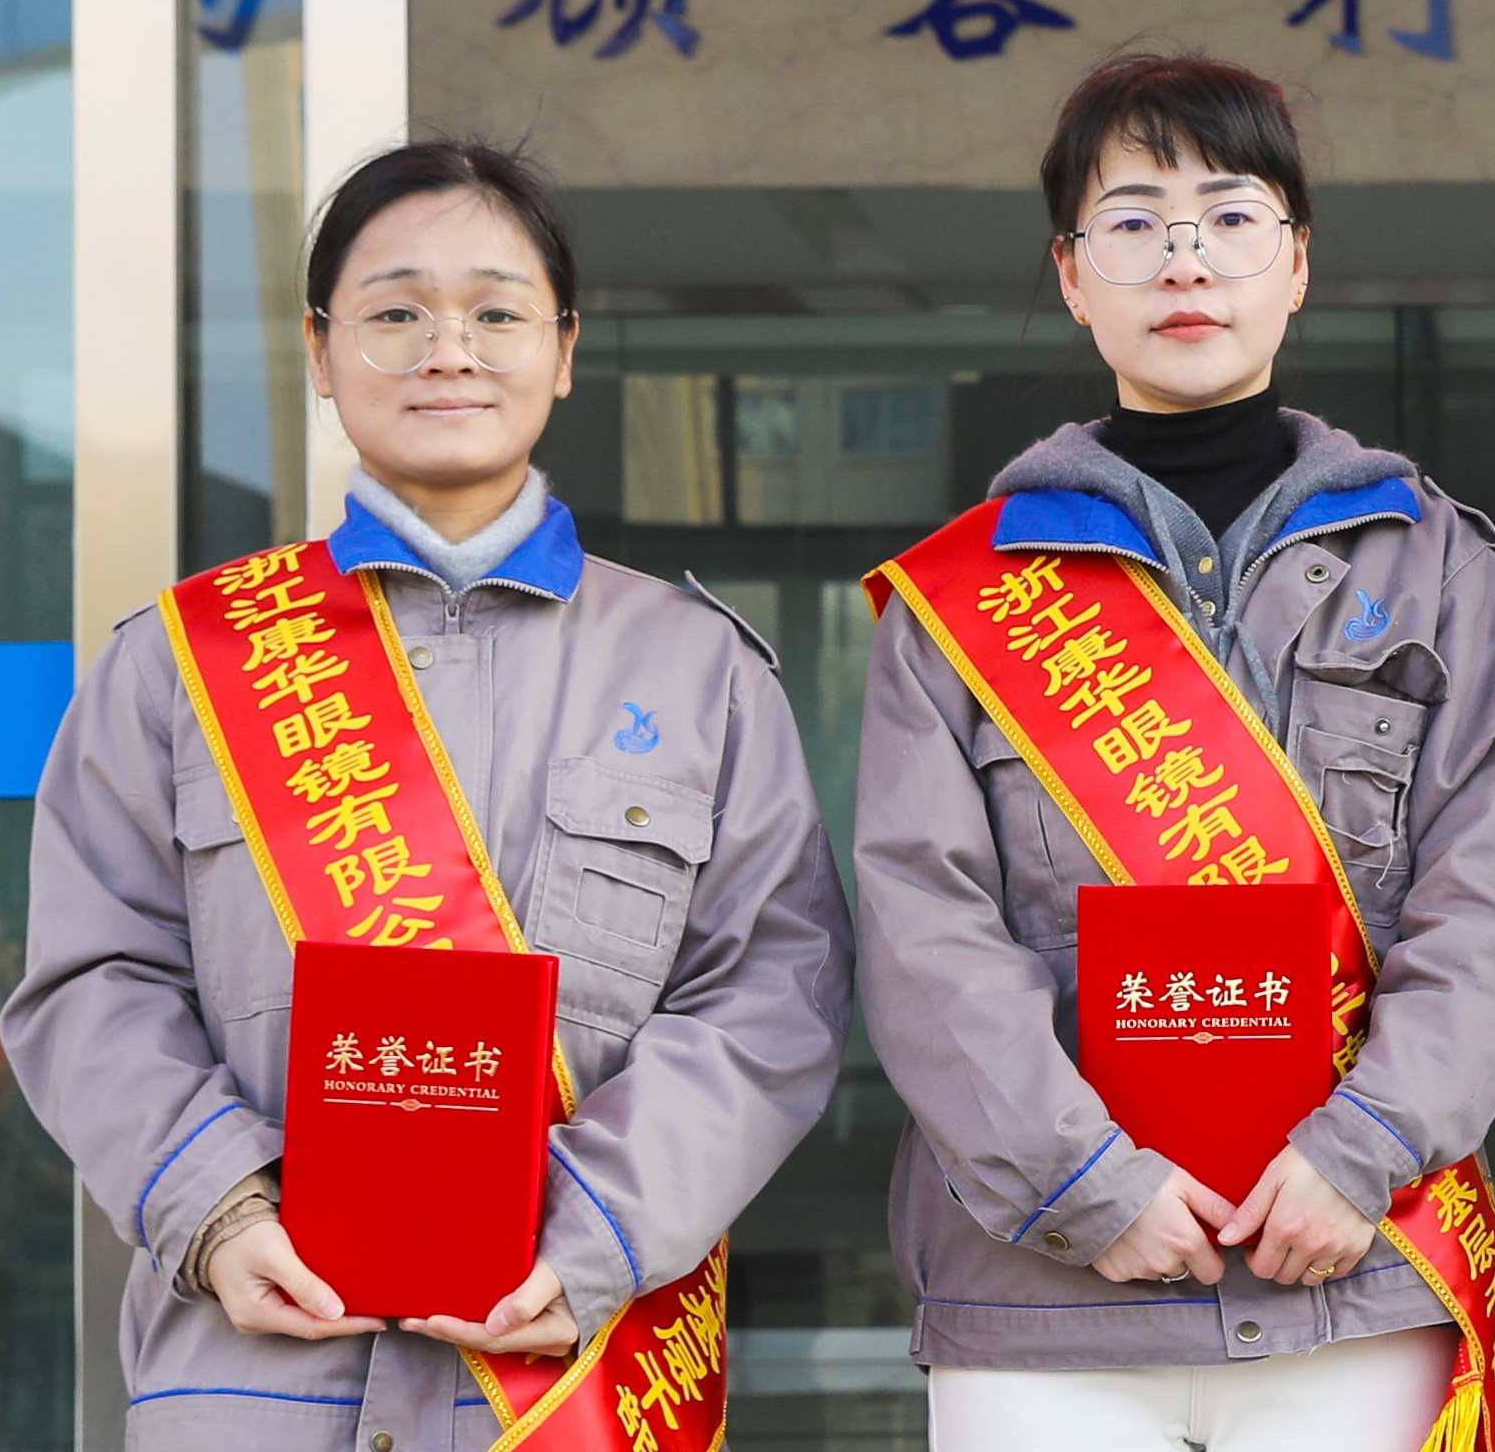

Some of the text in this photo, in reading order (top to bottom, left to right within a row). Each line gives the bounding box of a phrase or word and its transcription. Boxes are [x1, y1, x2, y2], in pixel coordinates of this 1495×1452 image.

[213, 541, 454, 950] 浙江康华眼镜有限公
[1115, 971, 1292, 1013] 荣誉证书
[1115, 1017, 1292, 1029] HONORARY CREDENTIAL
[325, 1032, 502, 1082] 荣誉证书
[324, 1079, 500, 1099] HONORARY CREDENTIAL
